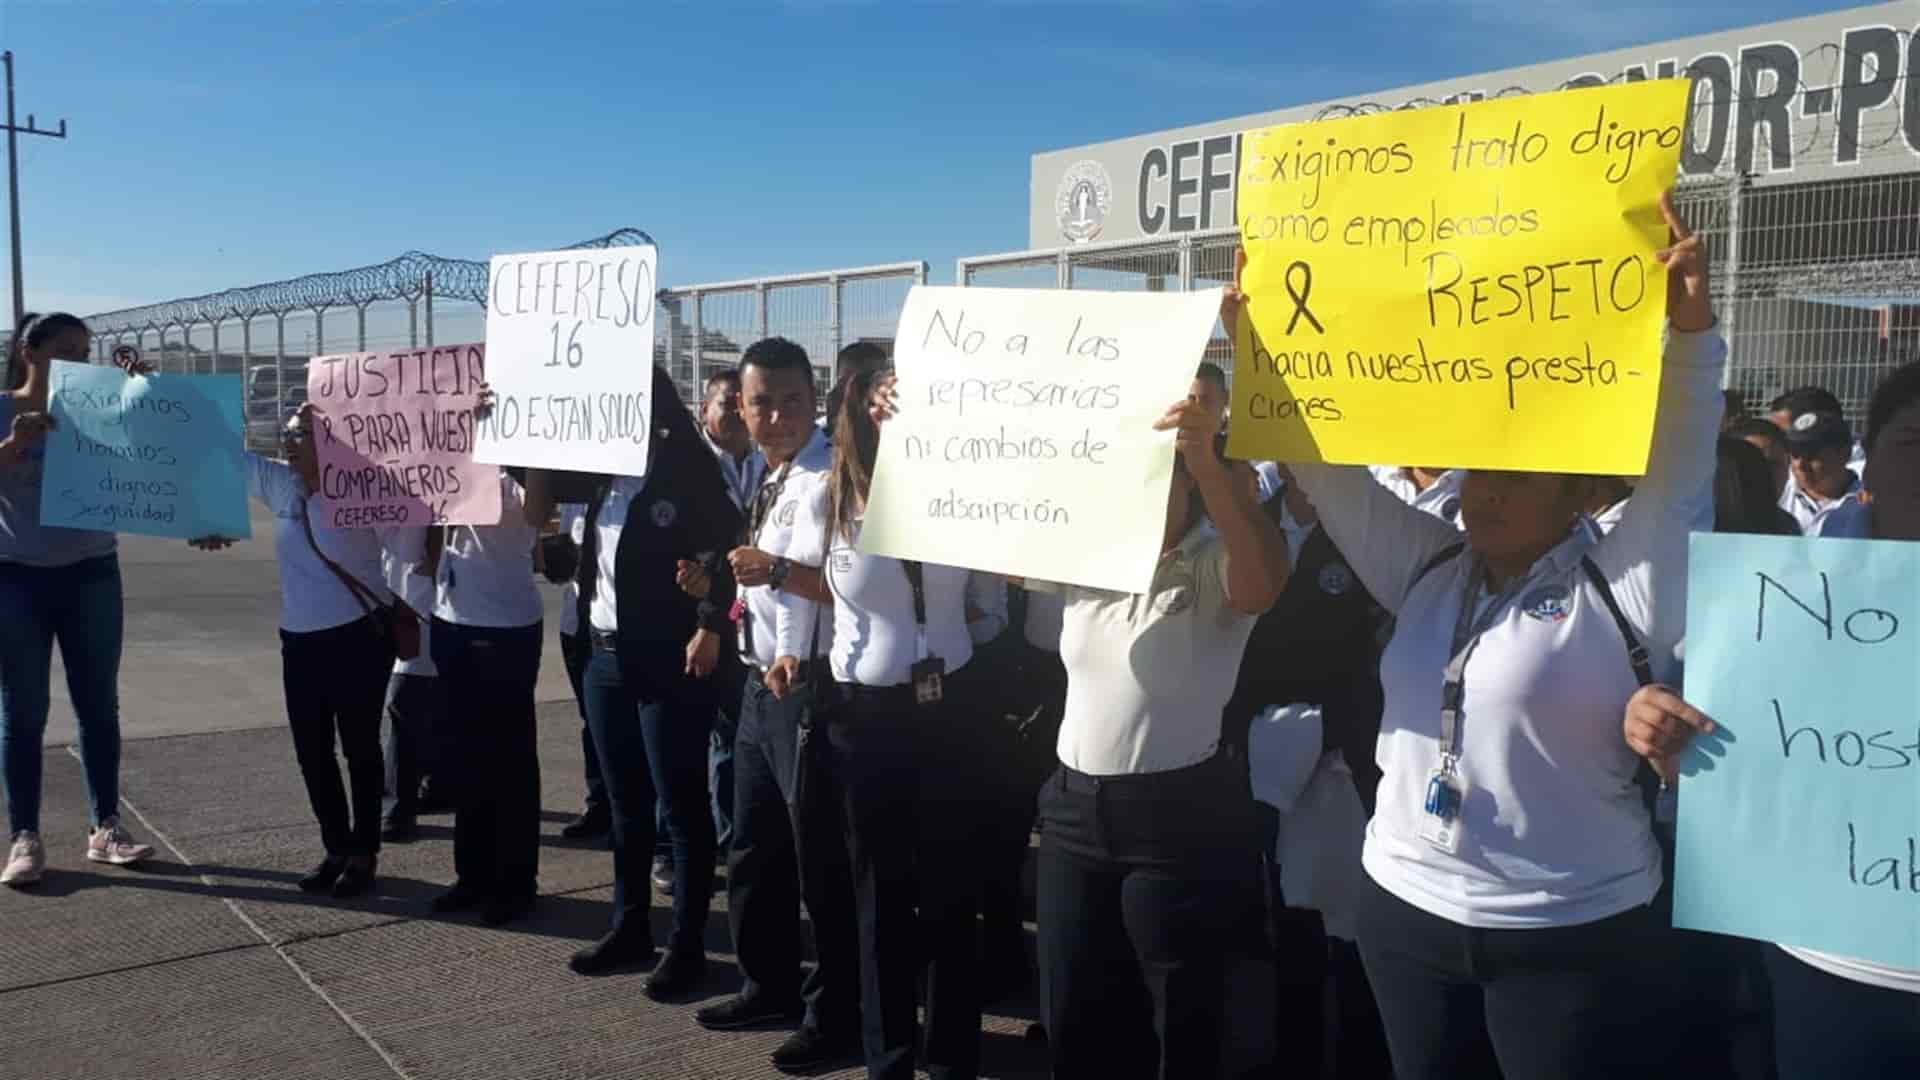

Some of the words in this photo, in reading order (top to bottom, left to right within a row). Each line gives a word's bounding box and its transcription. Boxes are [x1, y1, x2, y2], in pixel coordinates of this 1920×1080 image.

[1450, 110, 1549, 172] trato
[1570, 103, 1683, 184] digno
[1243, 213, 1329, 244] como
[1343, 194, 1539, 267] empleados
[493, 257, 653, 328] CEFERESO
[1422, 250, 1645, 329] RESPETO
[544, 319, 584, 368] 16
[922, 308, 985, 354] No
[1005, 334, 1030, 356] a
[1065, 315, 1121, 361] las
[1250, 332, 1333, 380] hacia
[1345, 338, 1494, 385] nuestras
[321, 346, 485, 399] JUSTICIA
[343, 413, 412, 454] PARA
[481, 393, 520, 442] NO
[527, 393, 593, 441] ESTAN
[599, 391, 646, 444] SOLOS
[904, 435, 932, 460] ni
[943, 425, 1059, 464] cambios
[1070, 428, 1108, 464] de
[322, 459, 461, 501] COMPAÑEROS
[334, 505, 409, 527] CEFERESO
[1755, 571, 1899, 644] No
